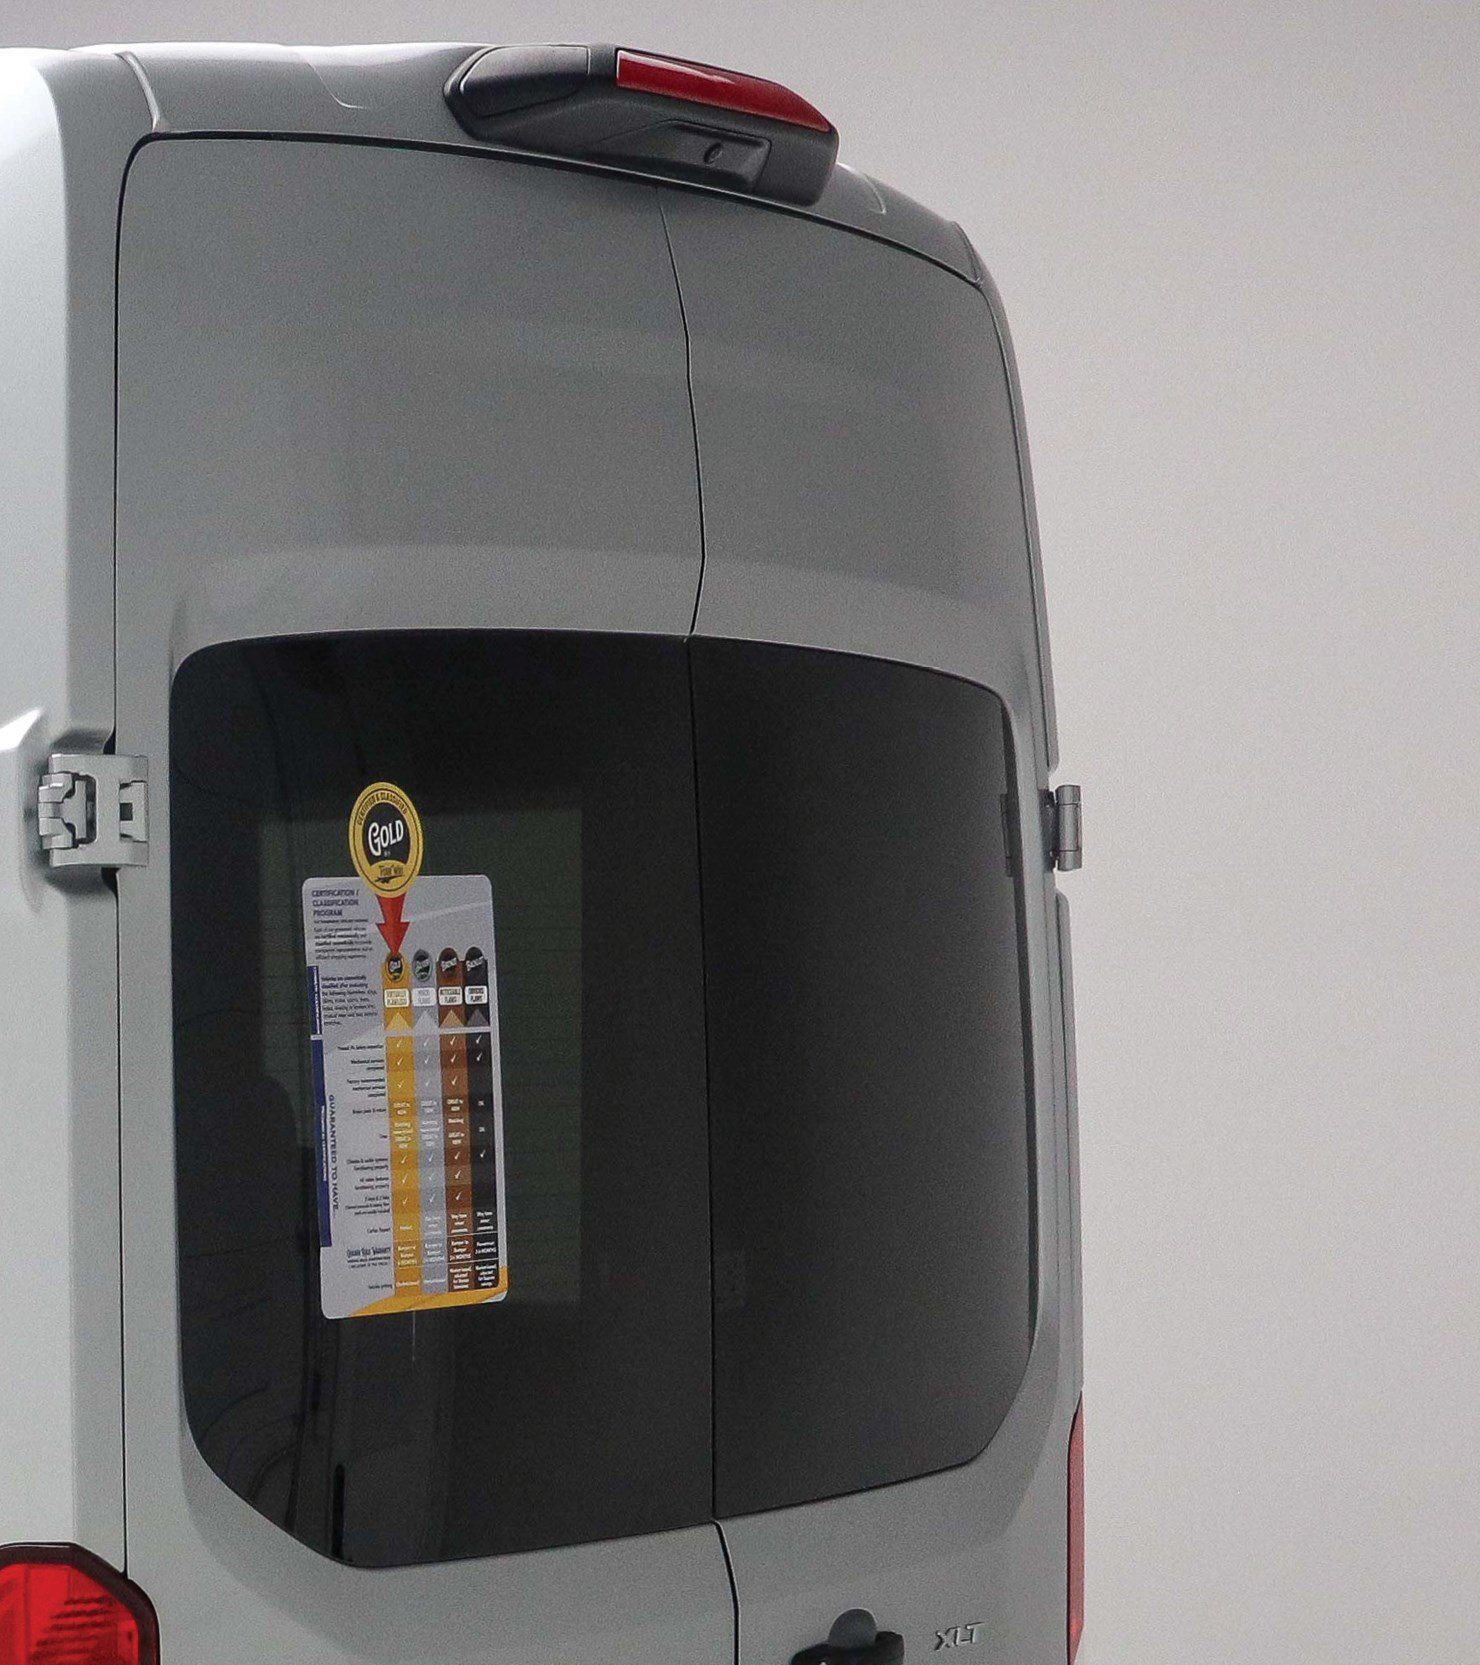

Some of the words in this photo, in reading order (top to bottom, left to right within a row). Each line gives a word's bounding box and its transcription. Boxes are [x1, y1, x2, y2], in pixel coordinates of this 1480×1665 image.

[368, 820, 404, 856] GOLD
[328, 1094, 337, 1164] GUARANTEED
[331, 1167, 338, 1180] TO
[934, 1621, 986, 1651] XLT
